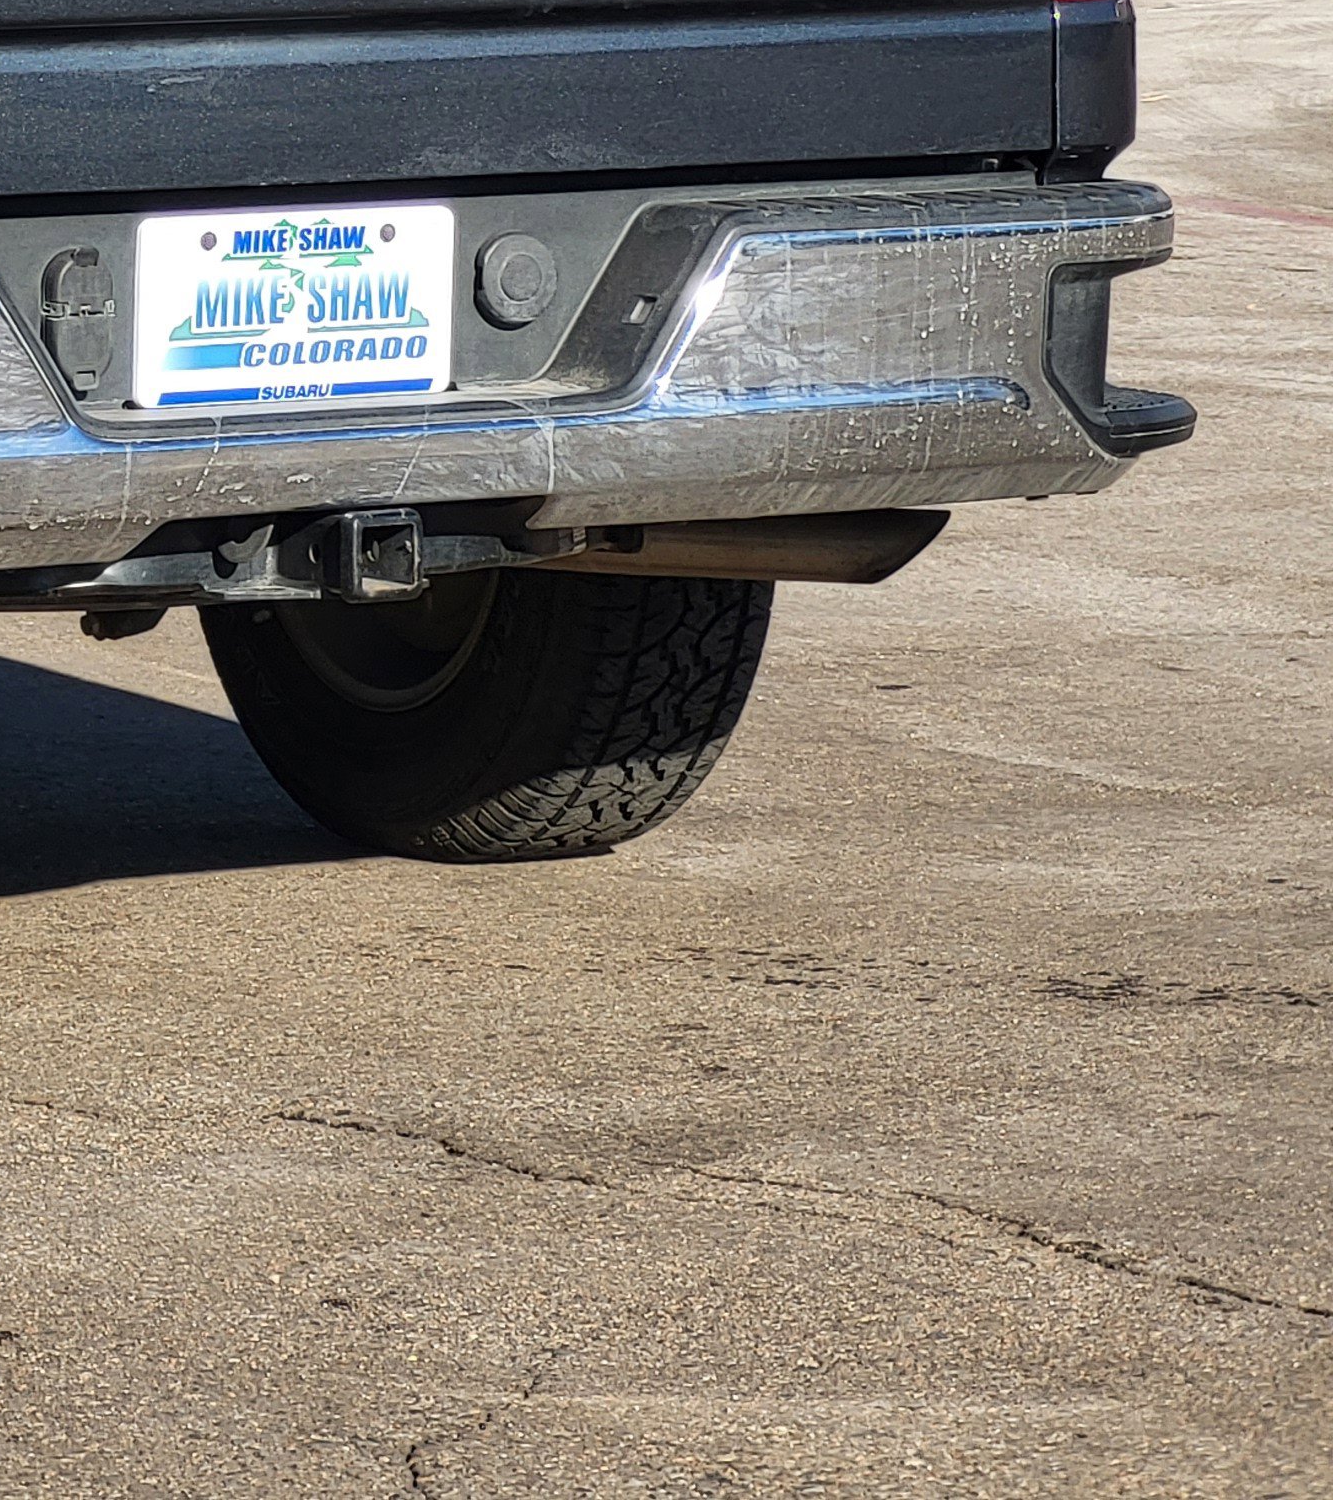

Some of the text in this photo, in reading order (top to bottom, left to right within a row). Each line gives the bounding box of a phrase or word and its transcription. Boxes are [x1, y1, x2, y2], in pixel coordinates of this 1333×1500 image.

[232, 226, 366, 254] MIKE SHAW
[195, 270, 410, 329] MIKE SHAW
[243, 335, 428, 368] COLORADO
[261, 383, 331, 400] SUBARU
